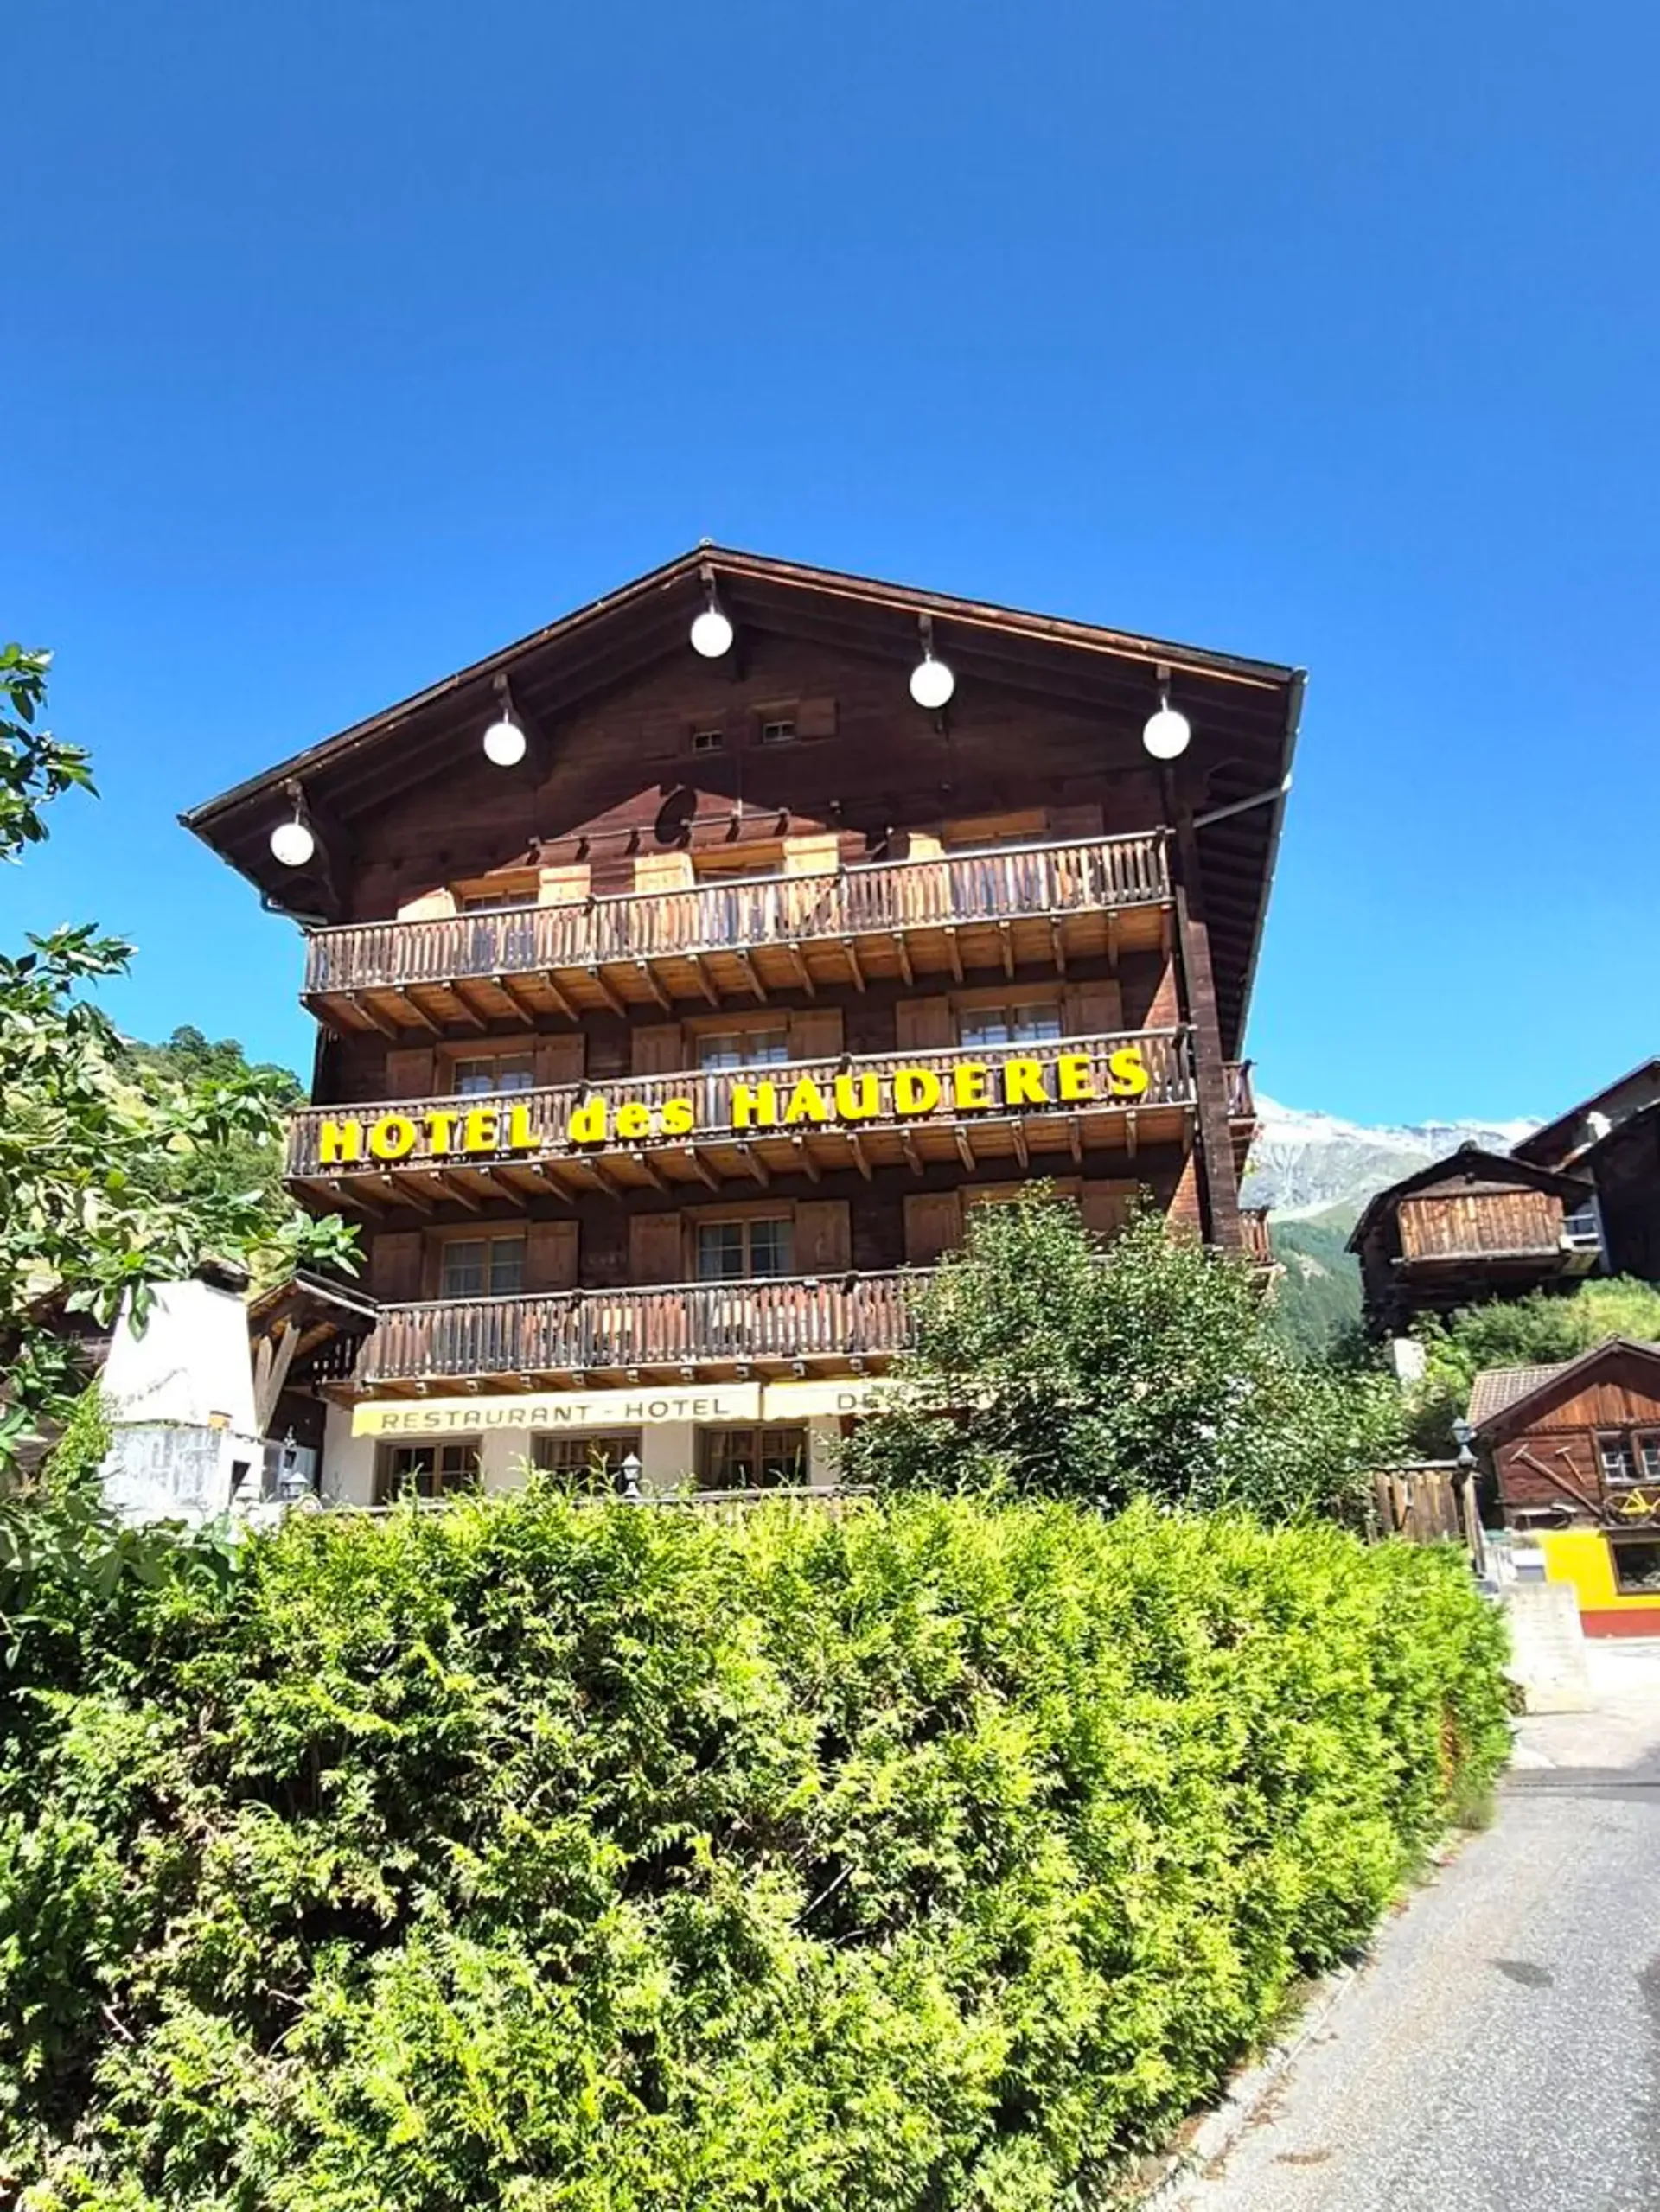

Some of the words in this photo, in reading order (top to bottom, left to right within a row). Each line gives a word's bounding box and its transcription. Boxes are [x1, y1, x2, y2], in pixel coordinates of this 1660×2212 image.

[319, 1105, 541, 1163] HOTEL
[570, 1096, 694, 1144] des
[732, 1047, 1149, 1128] HAUDERES
[381, 1405, 591, 1430] RESTAURANT
[625, 1398, 730, 1418] HOTEL
